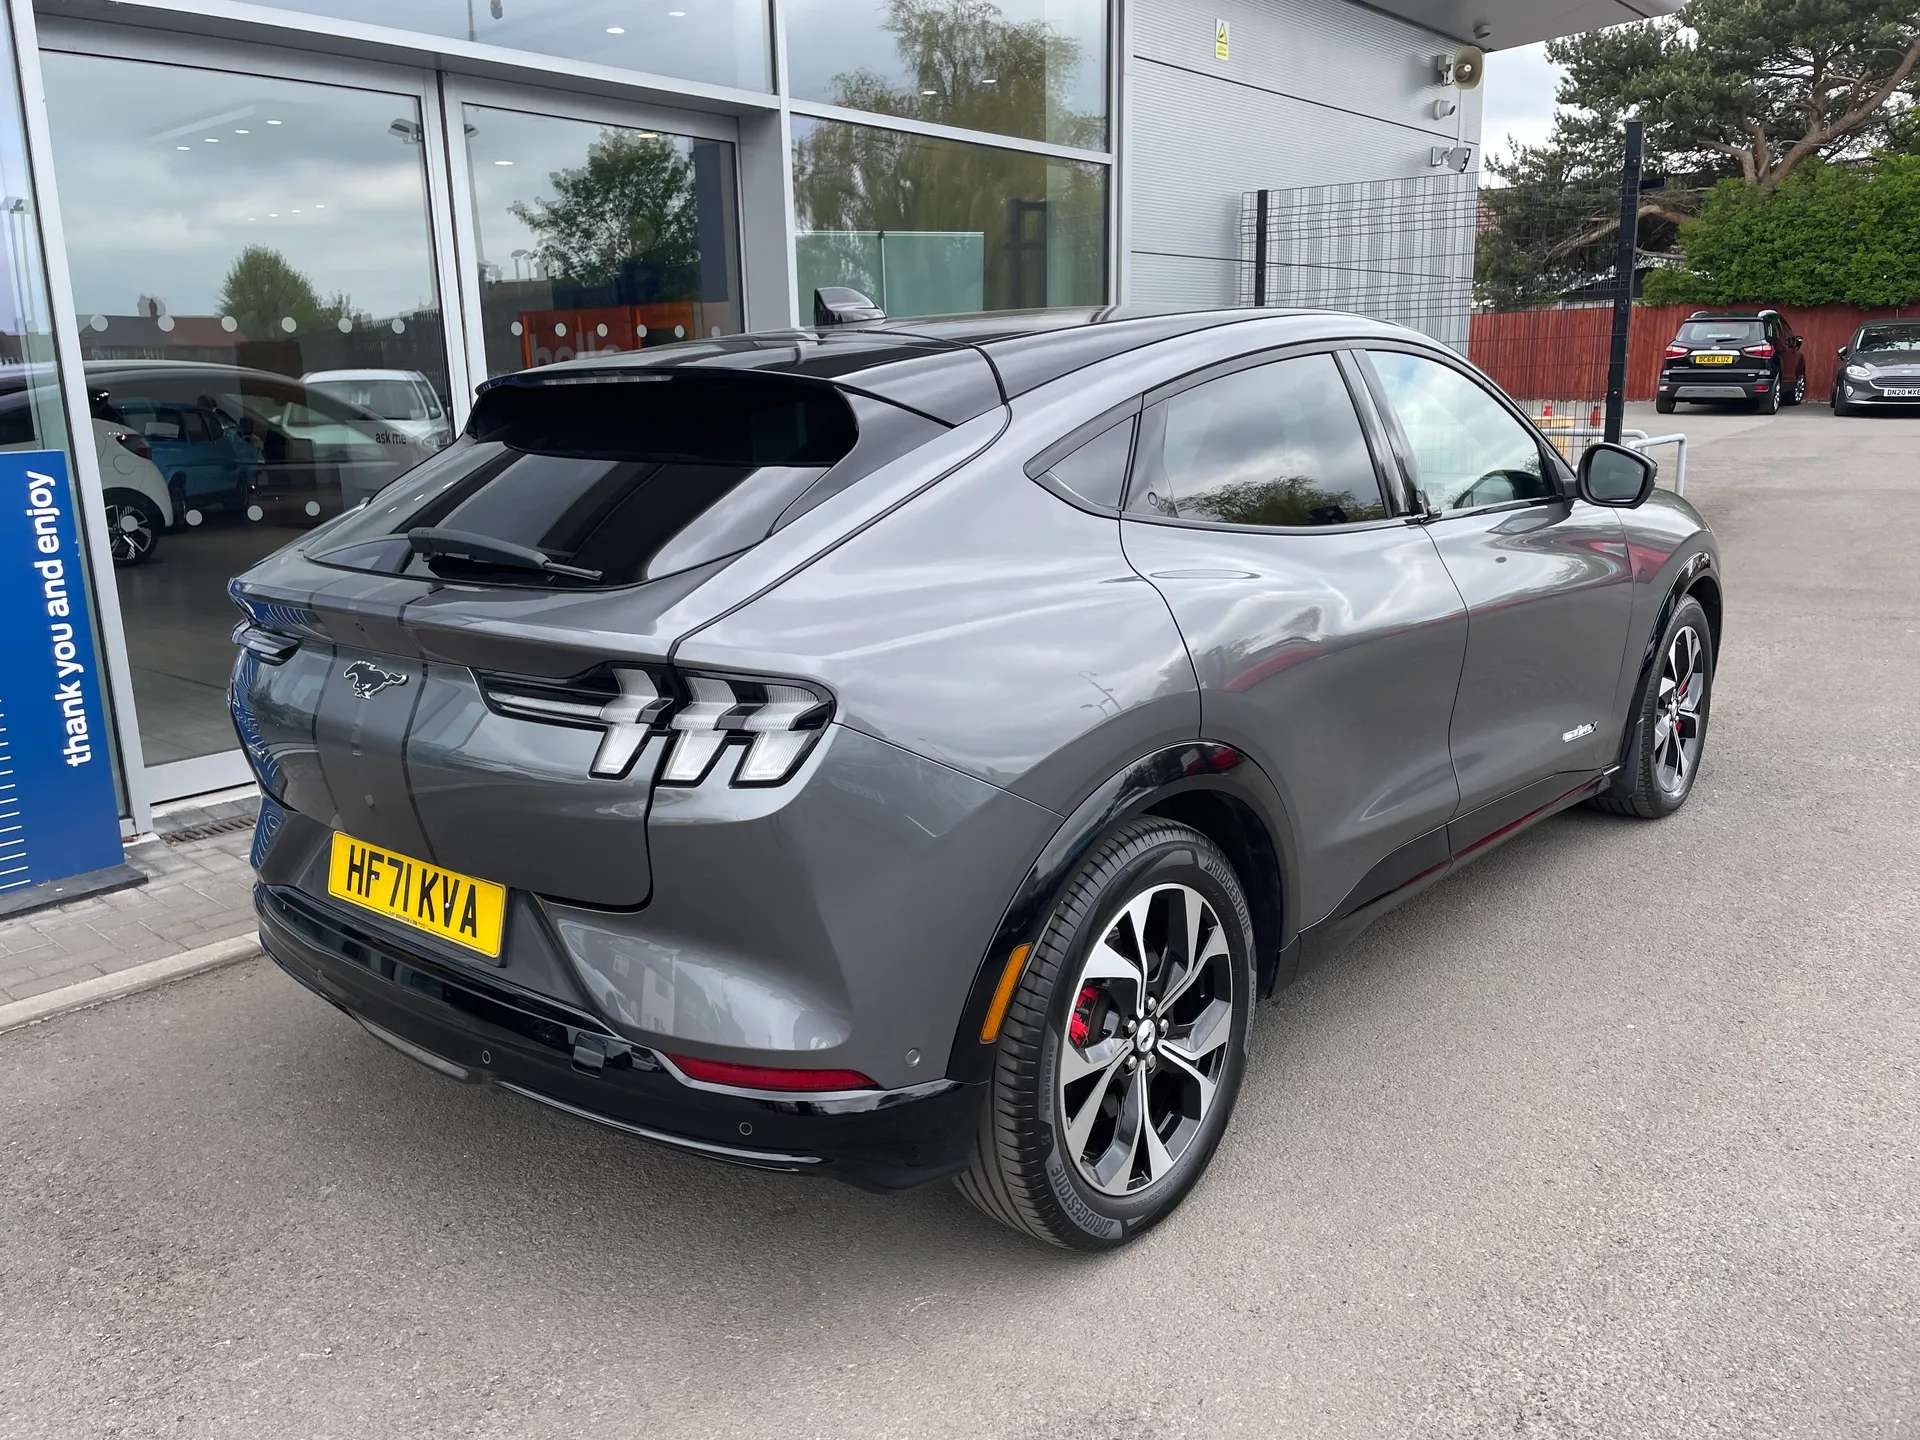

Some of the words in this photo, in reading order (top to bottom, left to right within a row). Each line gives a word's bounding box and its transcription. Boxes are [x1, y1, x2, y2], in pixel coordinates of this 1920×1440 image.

[375, 430, 391, 444] ask
[392, 433, 406, 445] me
[26, 470, 61, 554] enjoy
[33, 559, 70, 617] and
[51, 622, 84, 679] you
[54, 679, 92, 768] thank
[346, 844, 413, 913] HF71
[417, 867, 478, 938] KVA
[1204, 856, 1252, 935] BRIDGESTONE
[1050, 1163, 1115, 1238] BRIDGESTONE
